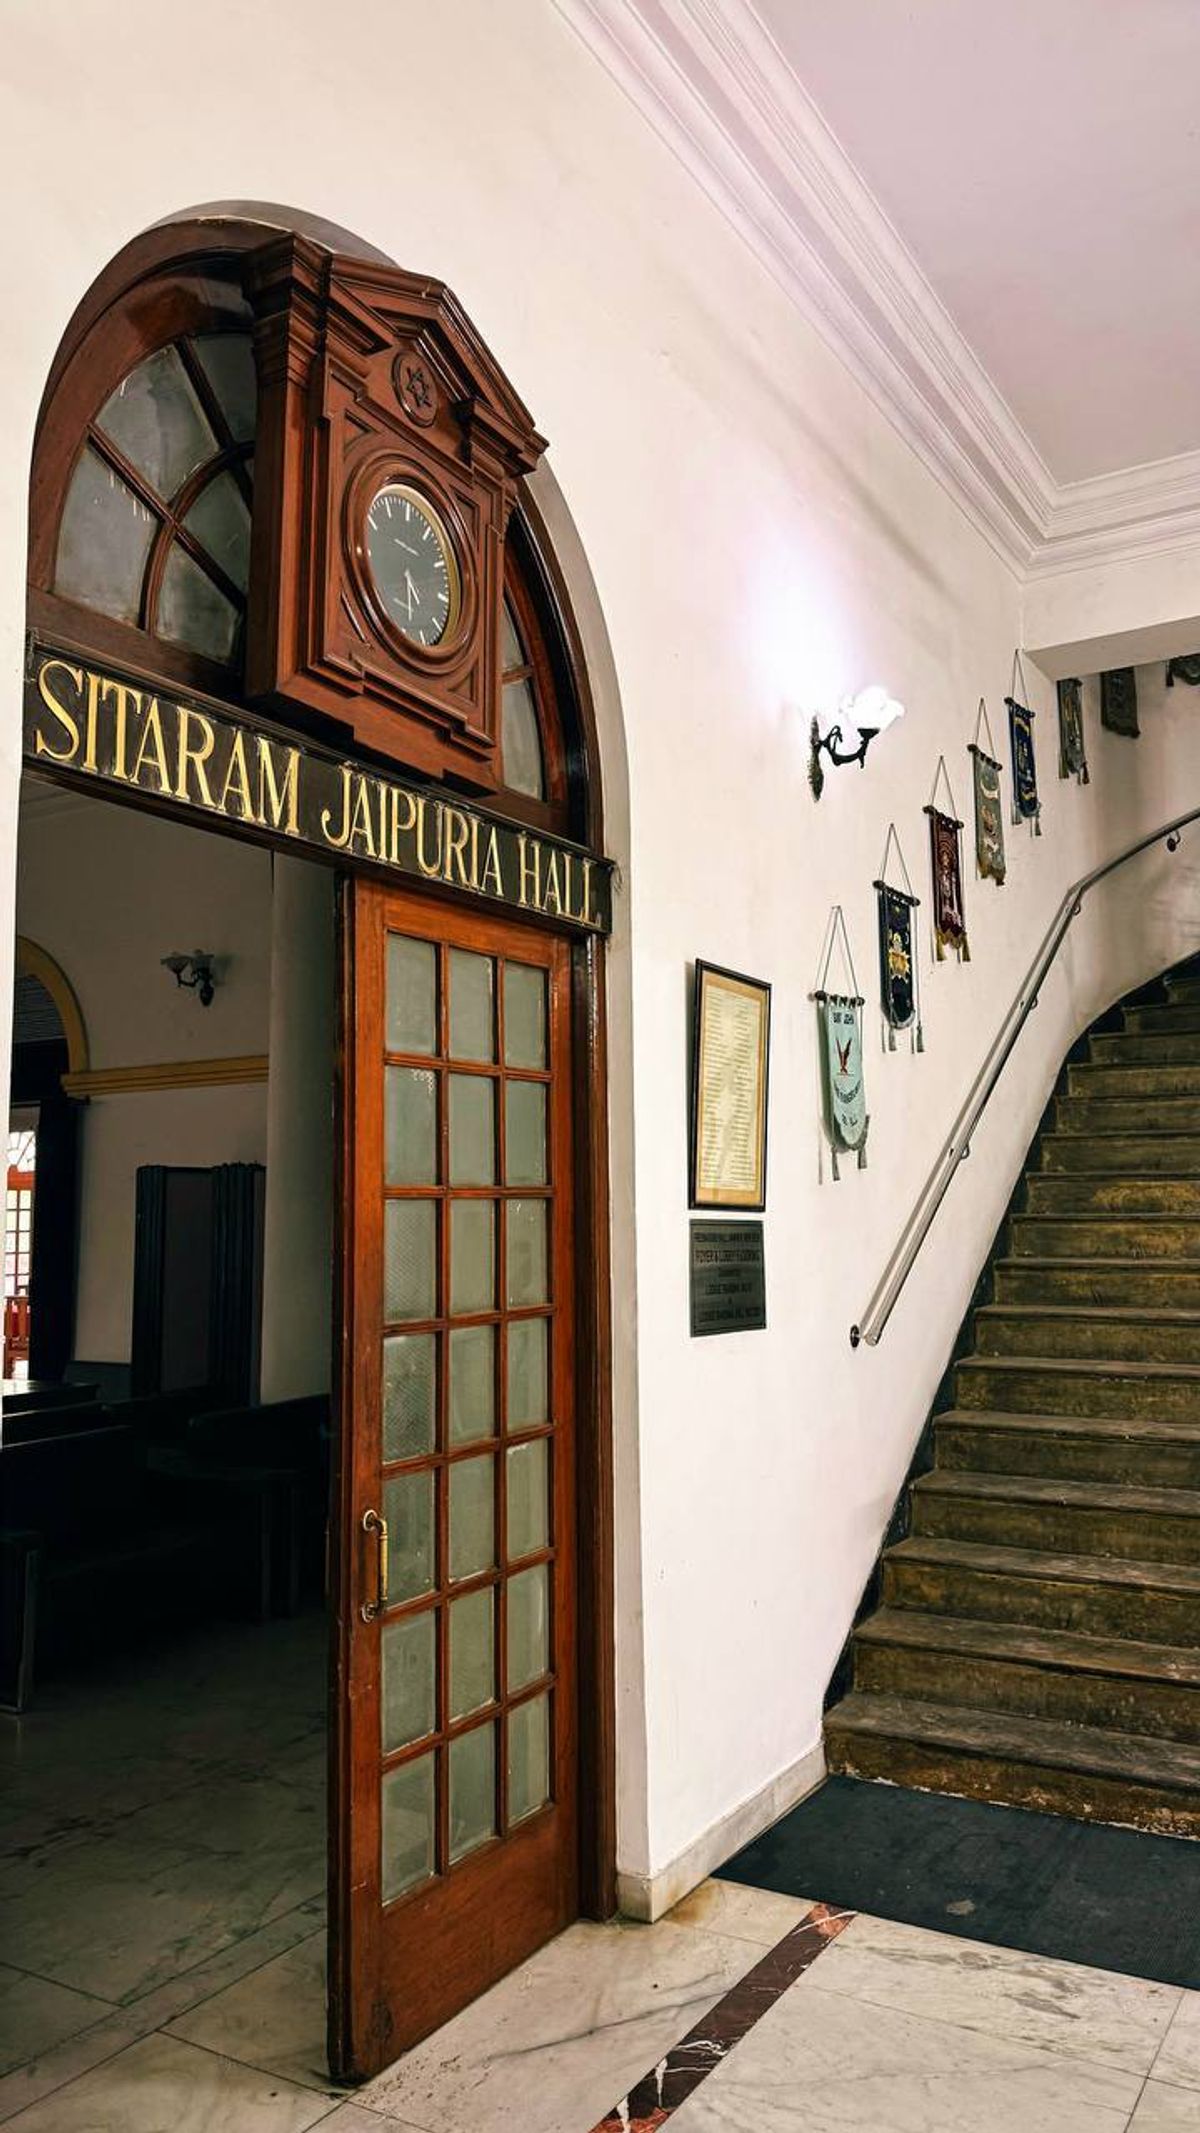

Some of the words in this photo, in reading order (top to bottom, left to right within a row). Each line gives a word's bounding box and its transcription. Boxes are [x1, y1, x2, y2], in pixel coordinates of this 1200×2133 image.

[36, 660, 301, 835] SITARAM
[321, 763, 504, 897] JAIPURIA
[517, 831, 601, 927] HALL
